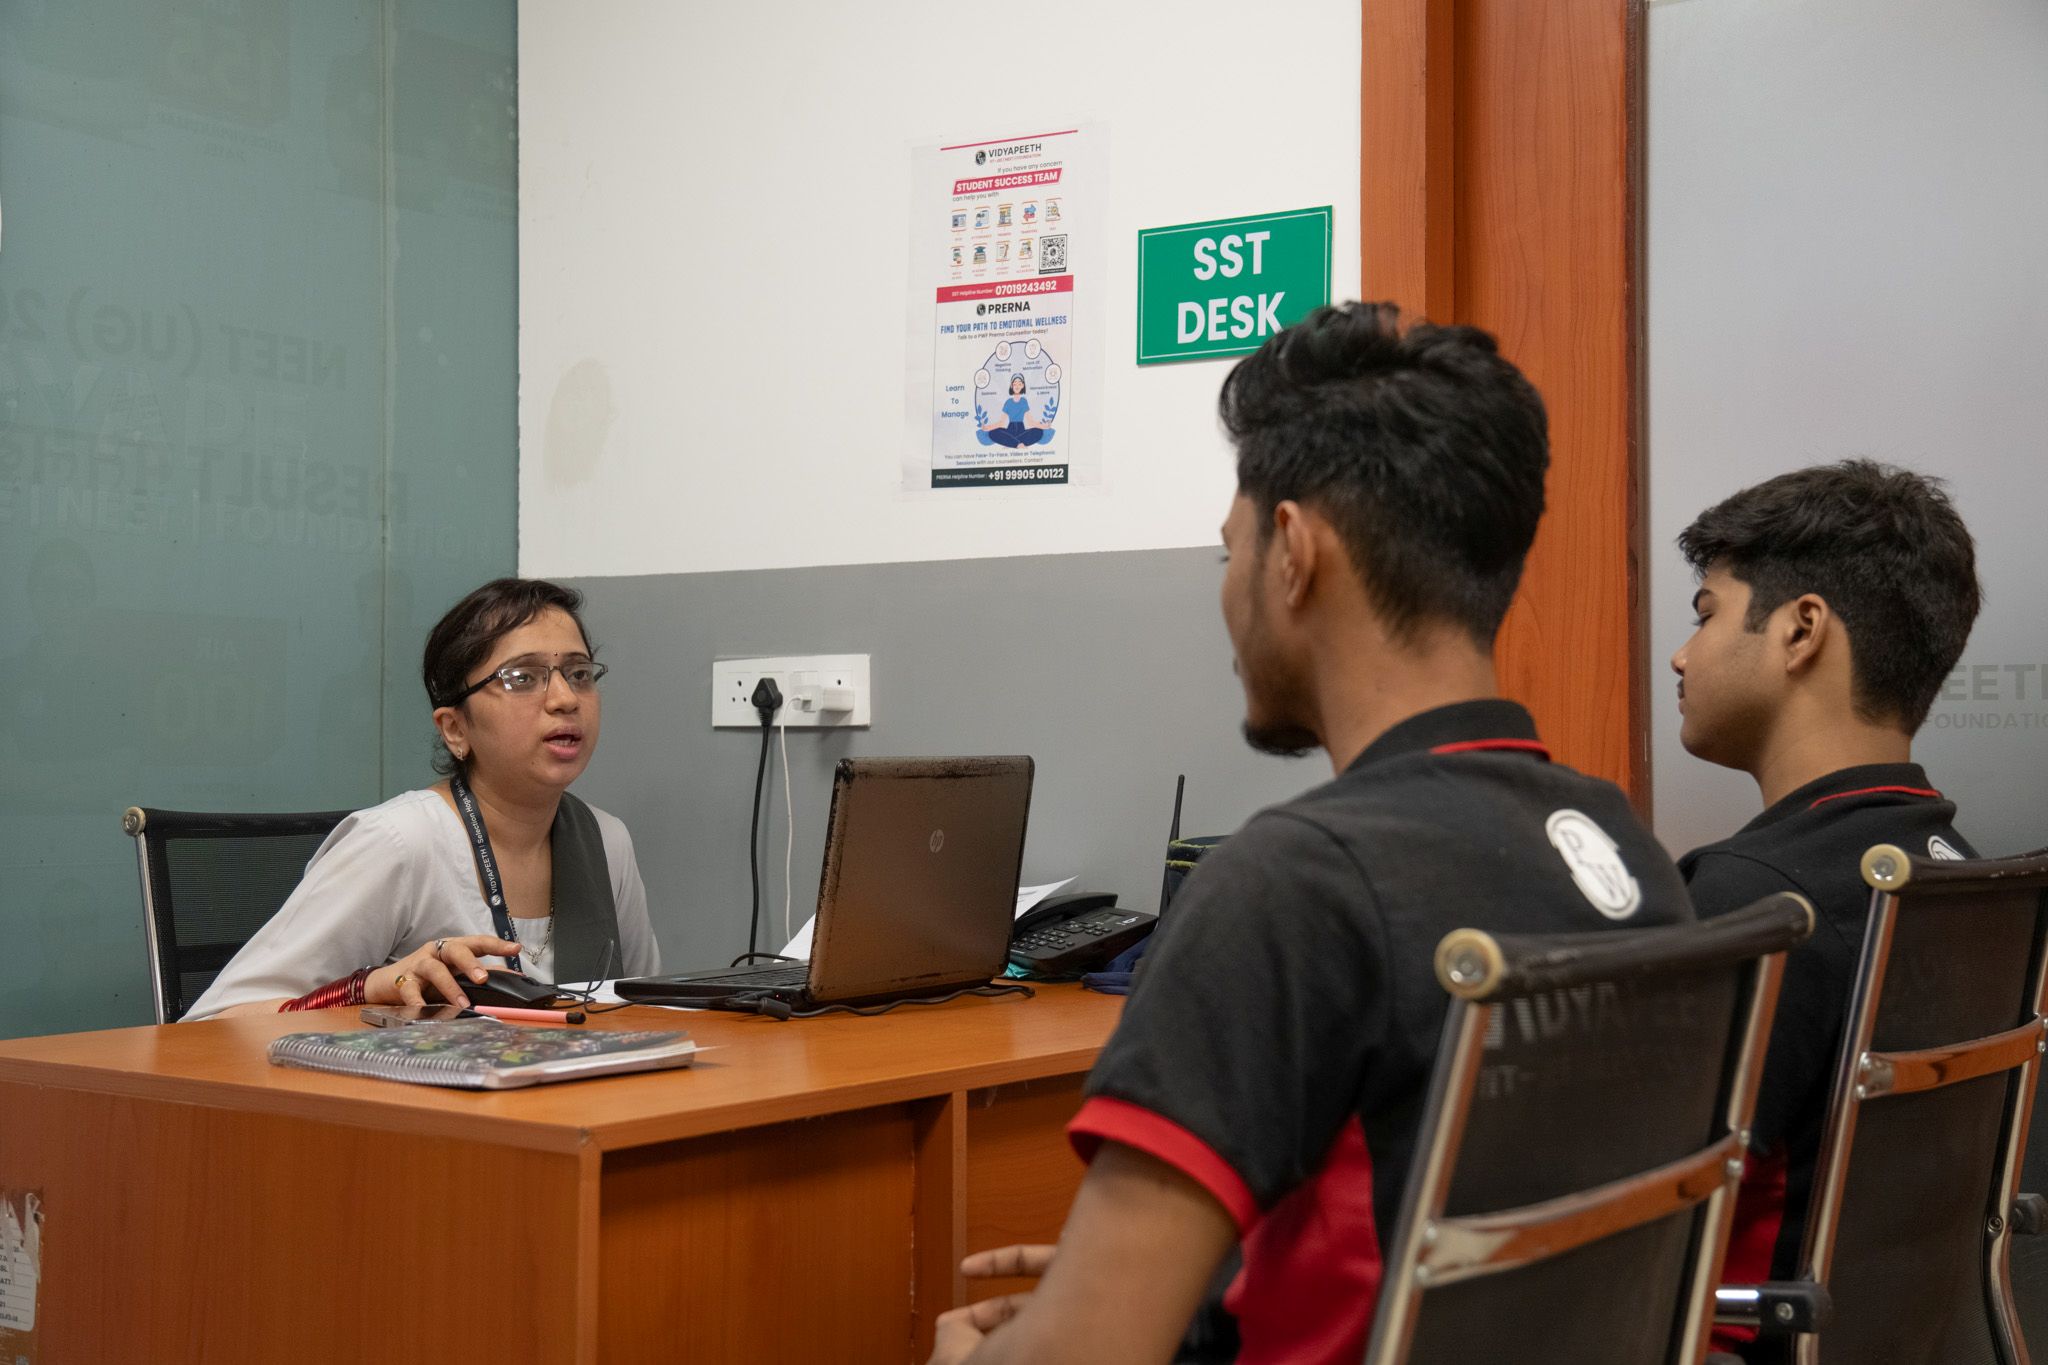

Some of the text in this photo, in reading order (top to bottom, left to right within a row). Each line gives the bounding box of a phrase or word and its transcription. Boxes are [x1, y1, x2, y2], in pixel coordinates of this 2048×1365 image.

[988, 143, 1042, 158] VIDYAPEETH
[956, 171, 1058, 192] STUDENT SUCCESS TEAM
[1194, 231, 1270, 280] SST
[995, 280, 1057, 296] 07019243492
[988, 301, 1030, 314] PRERNA
[940, 316, 1067, 334] FIND YOUR PATH TO EMOTIONAL WELLNESS
[1177, 292, 1286, 344] DESK
[941, 410, 969, 419] Manage
[988, 470, 1003, 480] +91
[1005, 469, 1035, 480] 99905
[1036, 468, 1064, 478] 00122
[469, 810, 484, 844] Selection
[480, 848, 498, 893] VIDYAPEETH
